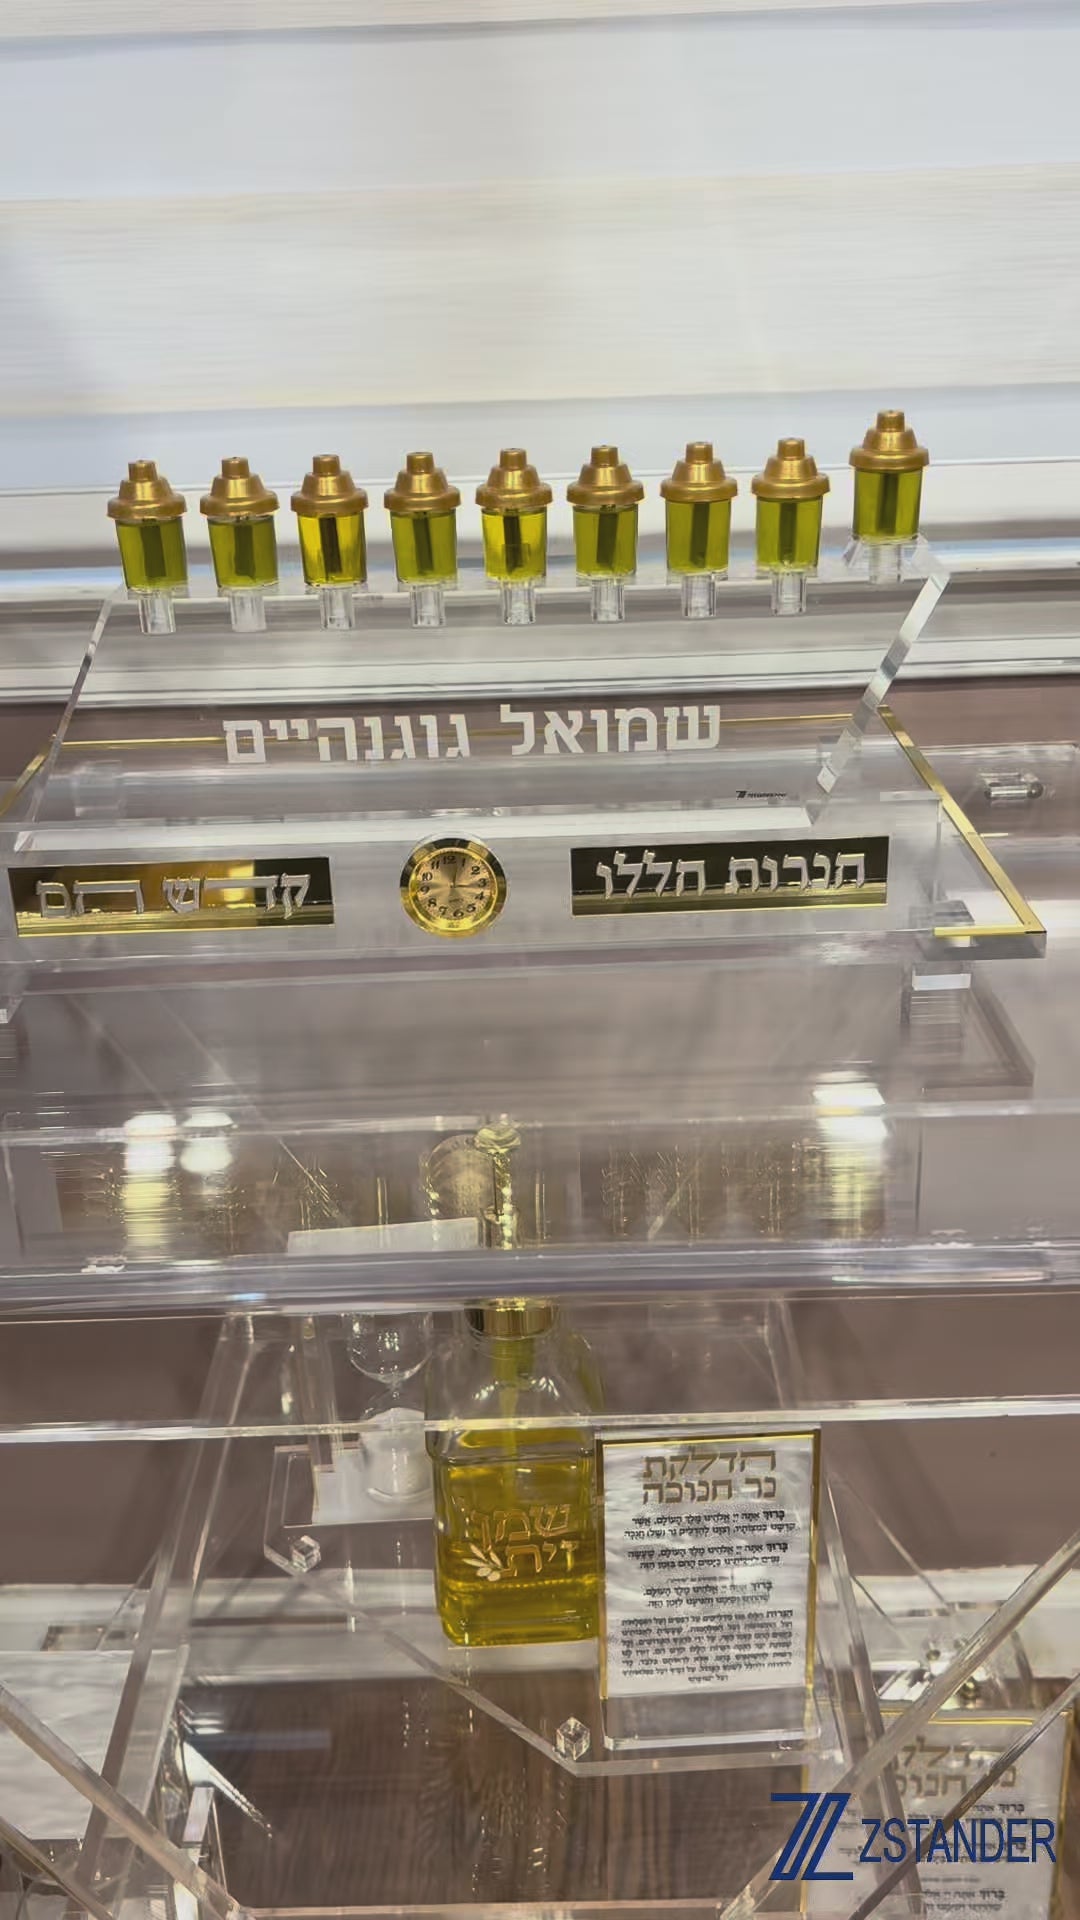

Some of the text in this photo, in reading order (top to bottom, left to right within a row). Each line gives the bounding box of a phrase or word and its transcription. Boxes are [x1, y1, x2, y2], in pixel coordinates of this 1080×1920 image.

[223, 703, 721, 764] שמואל גוגנהיים
[431, 860, 439, 870] 11
[443, 855, 456, 865] 12
[462, 858, 466, 868] 1
[471, 865, 480, 875] 2
[596, 849, 865, 899] הנרות הללו
[422, 871, 433, 881] 10
[478, 877, 487, 888] 3
[420, 885, 430, 895] 9
[36, 872, 311, 920] קדש הם
[475, 891, 484, 901] 4
[428, 897, 437, 908] 8
[438, 905, 448, 915] 7
[453, 908, 464, 918] 6
[466, 903, 476, 913] 5
[642, 1445, 777, 1480] הדלקת
[643, 1476, 777, 1505] נר חנוכה
[471, 1503, 571, 1551] שמן
[500, 1539, 578, 1577] זית
